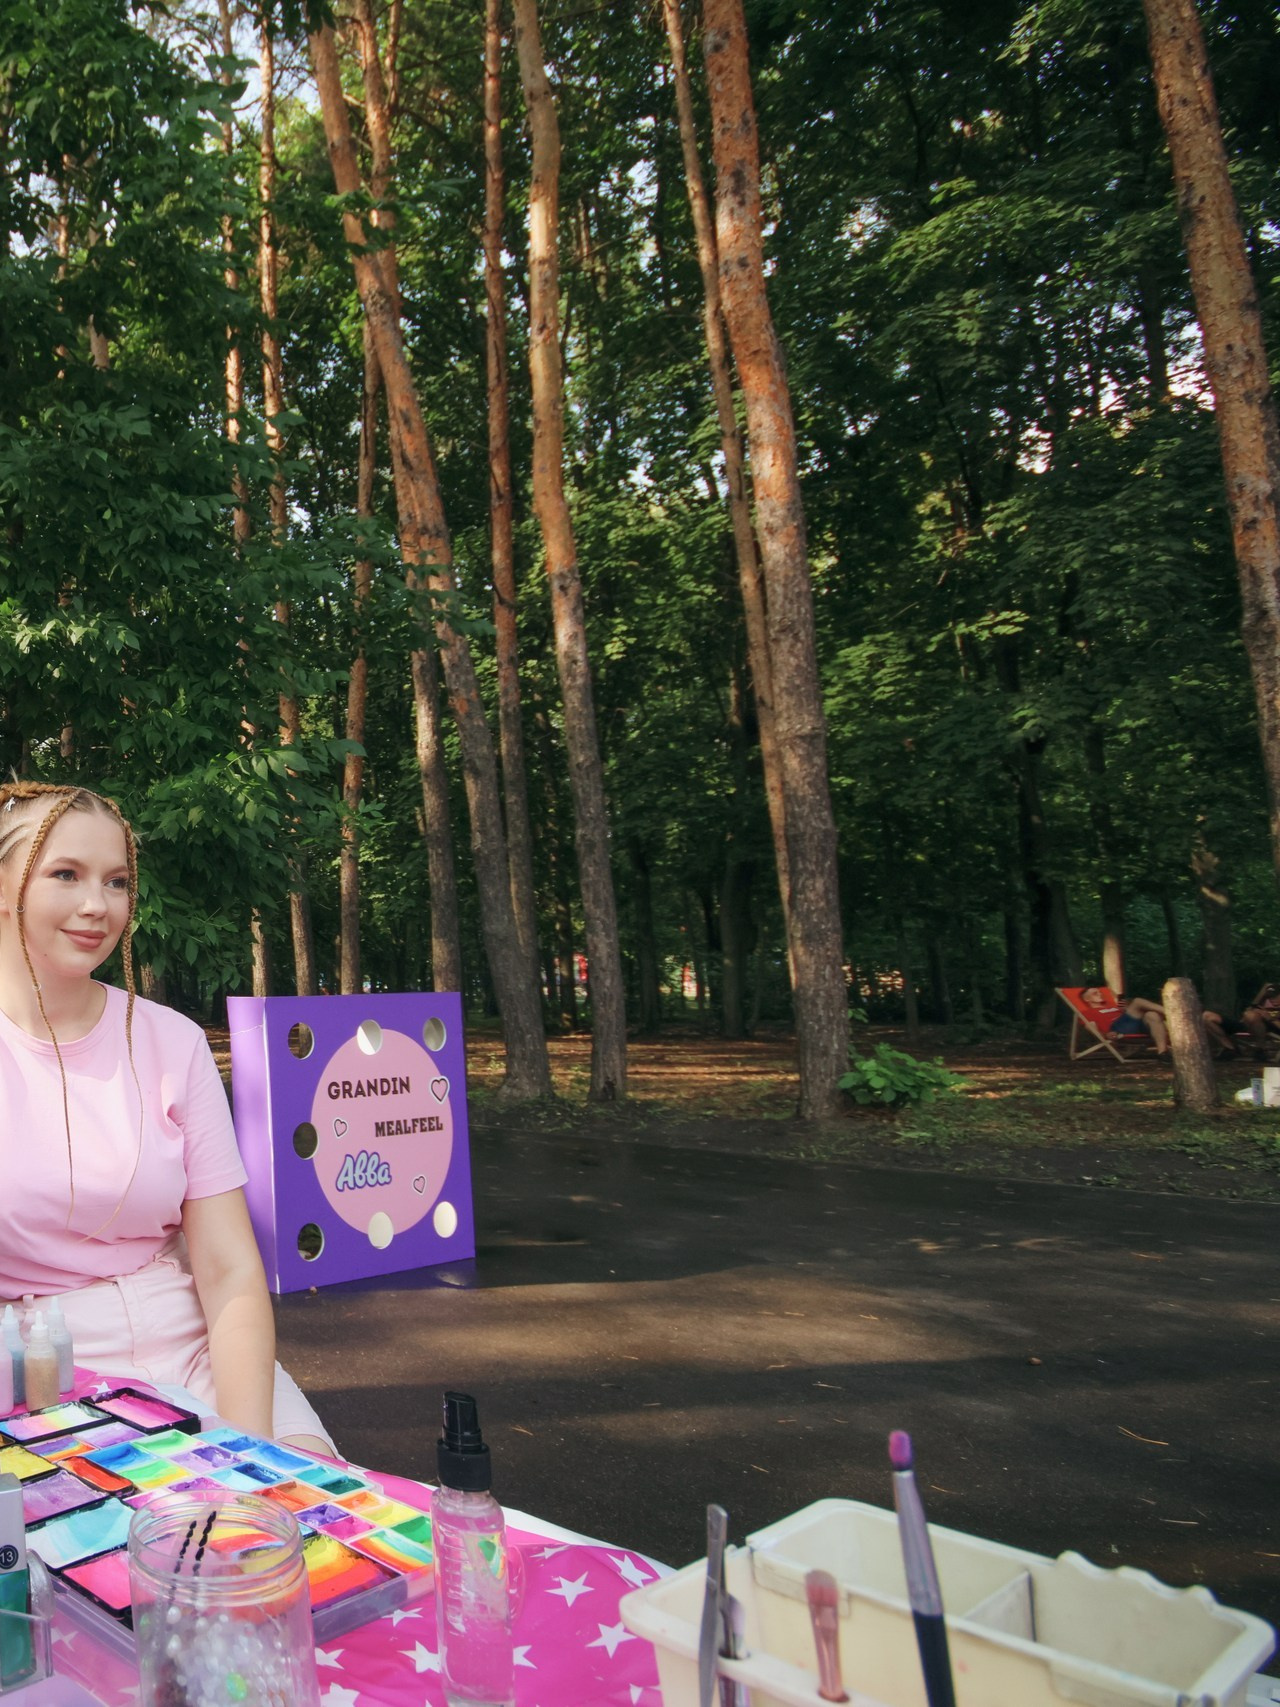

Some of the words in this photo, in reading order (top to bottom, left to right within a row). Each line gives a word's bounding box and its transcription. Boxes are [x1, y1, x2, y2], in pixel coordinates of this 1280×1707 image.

[327, 1076, 411, 1100] GRANDIN
[374, 1116, 444, 1138] MEALFEEL
[0, 1550, 14, 1564] 13
